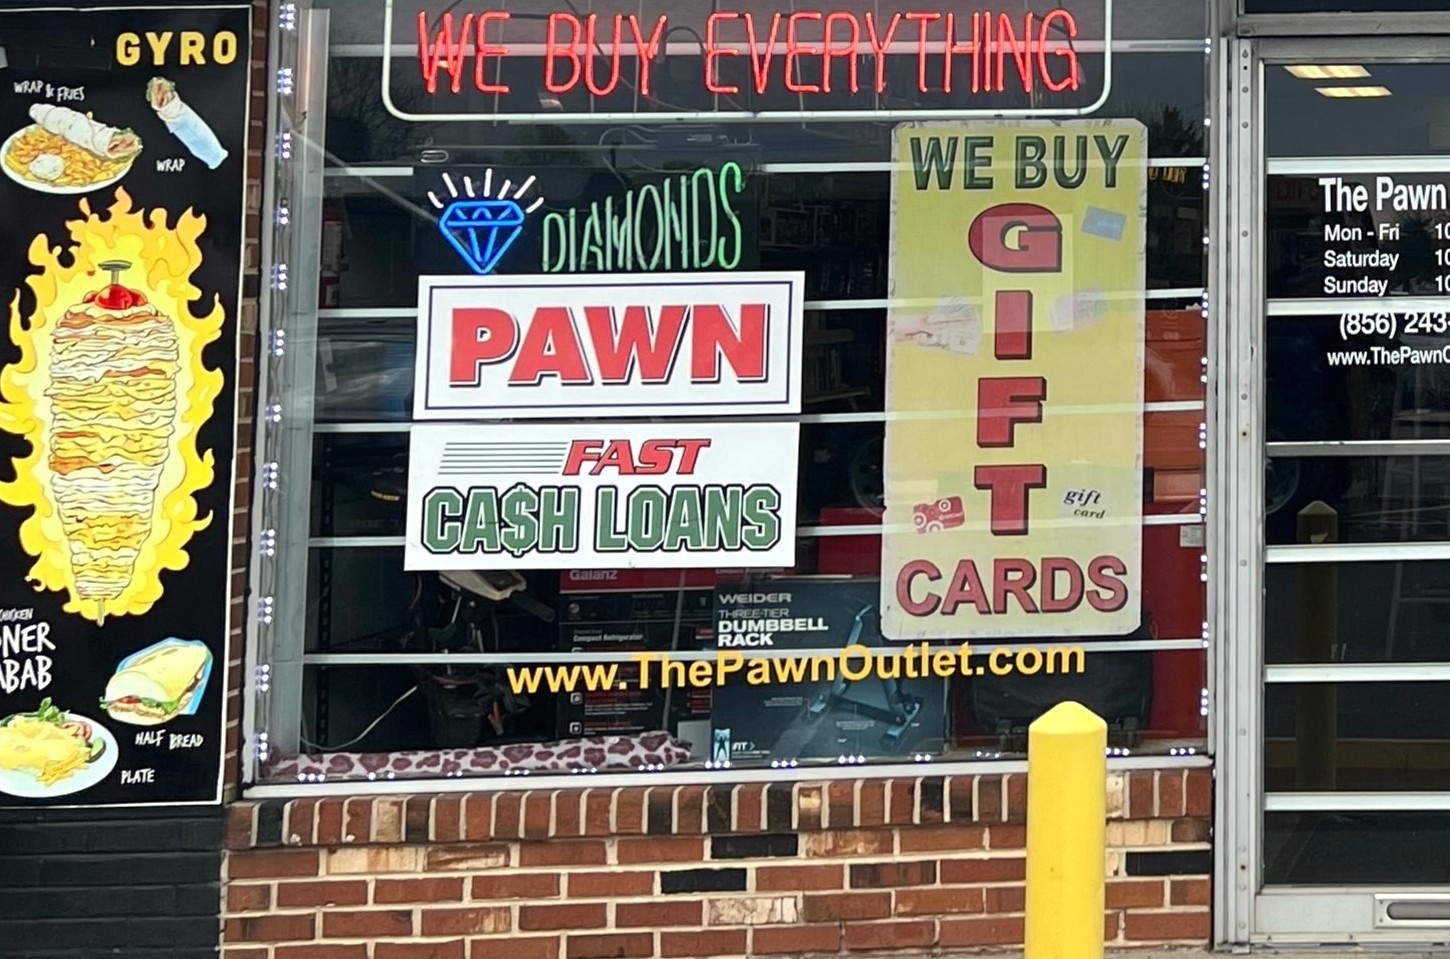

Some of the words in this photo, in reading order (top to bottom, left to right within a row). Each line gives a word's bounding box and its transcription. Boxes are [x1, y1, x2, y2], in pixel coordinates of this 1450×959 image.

[116, 30, 238, 67] GYRO
[416, 10, 511, 95] WE
[544, 12, 668, 97] BUY
[703, 8, 1082, 97] EVERYTHING
[13, 79, 44, 94] WRAP
[56, 86, 86, 103] FRIES
[155, 157, 186, 173] WRAP
[909, 136, 995, 192] WE
[1013, 134, 1131, 191] BUY
[1318, 176, 1369, 213] The
[1376, 175, 1447, 212] Pawn
[542, 161, 743, 273] DIAMONDS
[1324, 224, 1363, 242] Mon
[1379, 222, 1400, 241] Fri
[1323, 249, 1400, 271] Saturday
[1323, 275, 1389, 298] Sunday
[1339, 311, 1397, 341] (856)
[450, 303, 769, 388] PAWN
[968, 202, 1064, 537] GIFT
[561, 437, 712, 477] FAST
[1063, 488, 1103, 507] gift
[421, 481, 582, 559] CA$H
[593, 482, 783, 554] LOANS
[1073, 508, 1106, 520] card
[719, 592, 793, 604] WEIDER
[896, 555, 1129, 617] CARDS
[718, 607, 790, 619] THREE-TIER
[718, 617, 830, 633] DUMBBELL
[0, 622, 56, 659] NER
[717, 632, 774, 648] RACK
[507, 642, 1087, 696] www.ThePawnOutlet.com
[134, 728, 167, 747] HALF
[169, 732, 204, 751] BREAD
[120, 767, 156, 785] PLATE
